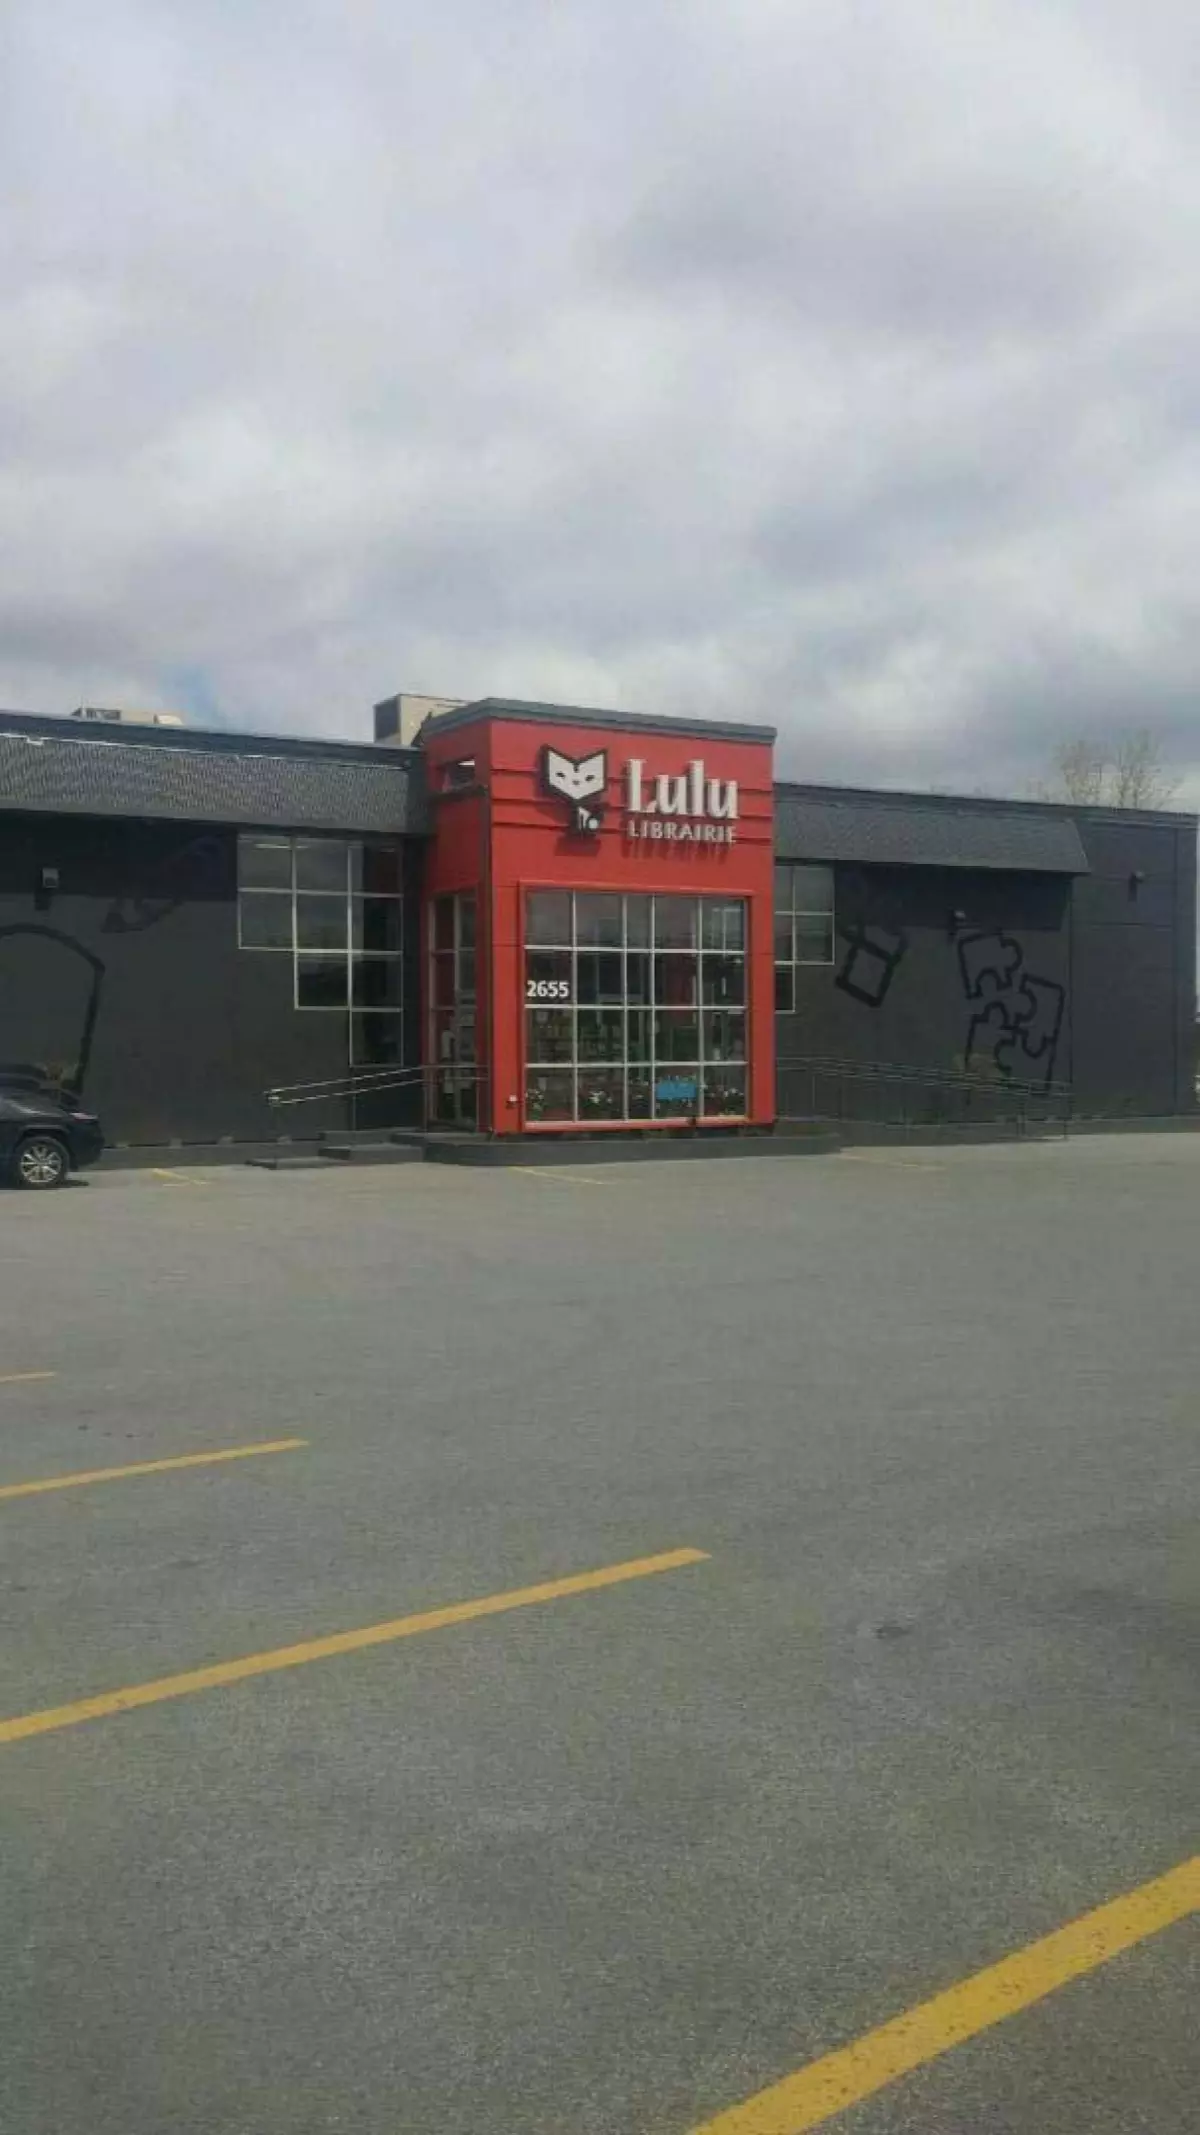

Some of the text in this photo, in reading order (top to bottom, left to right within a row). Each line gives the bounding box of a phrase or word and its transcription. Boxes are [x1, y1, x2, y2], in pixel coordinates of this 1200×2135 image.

[627, 759, 740, 819] Lulu
[629, 820, 737, 843] LIBRAIRIE
[526, 980, 570, 998] 2655
